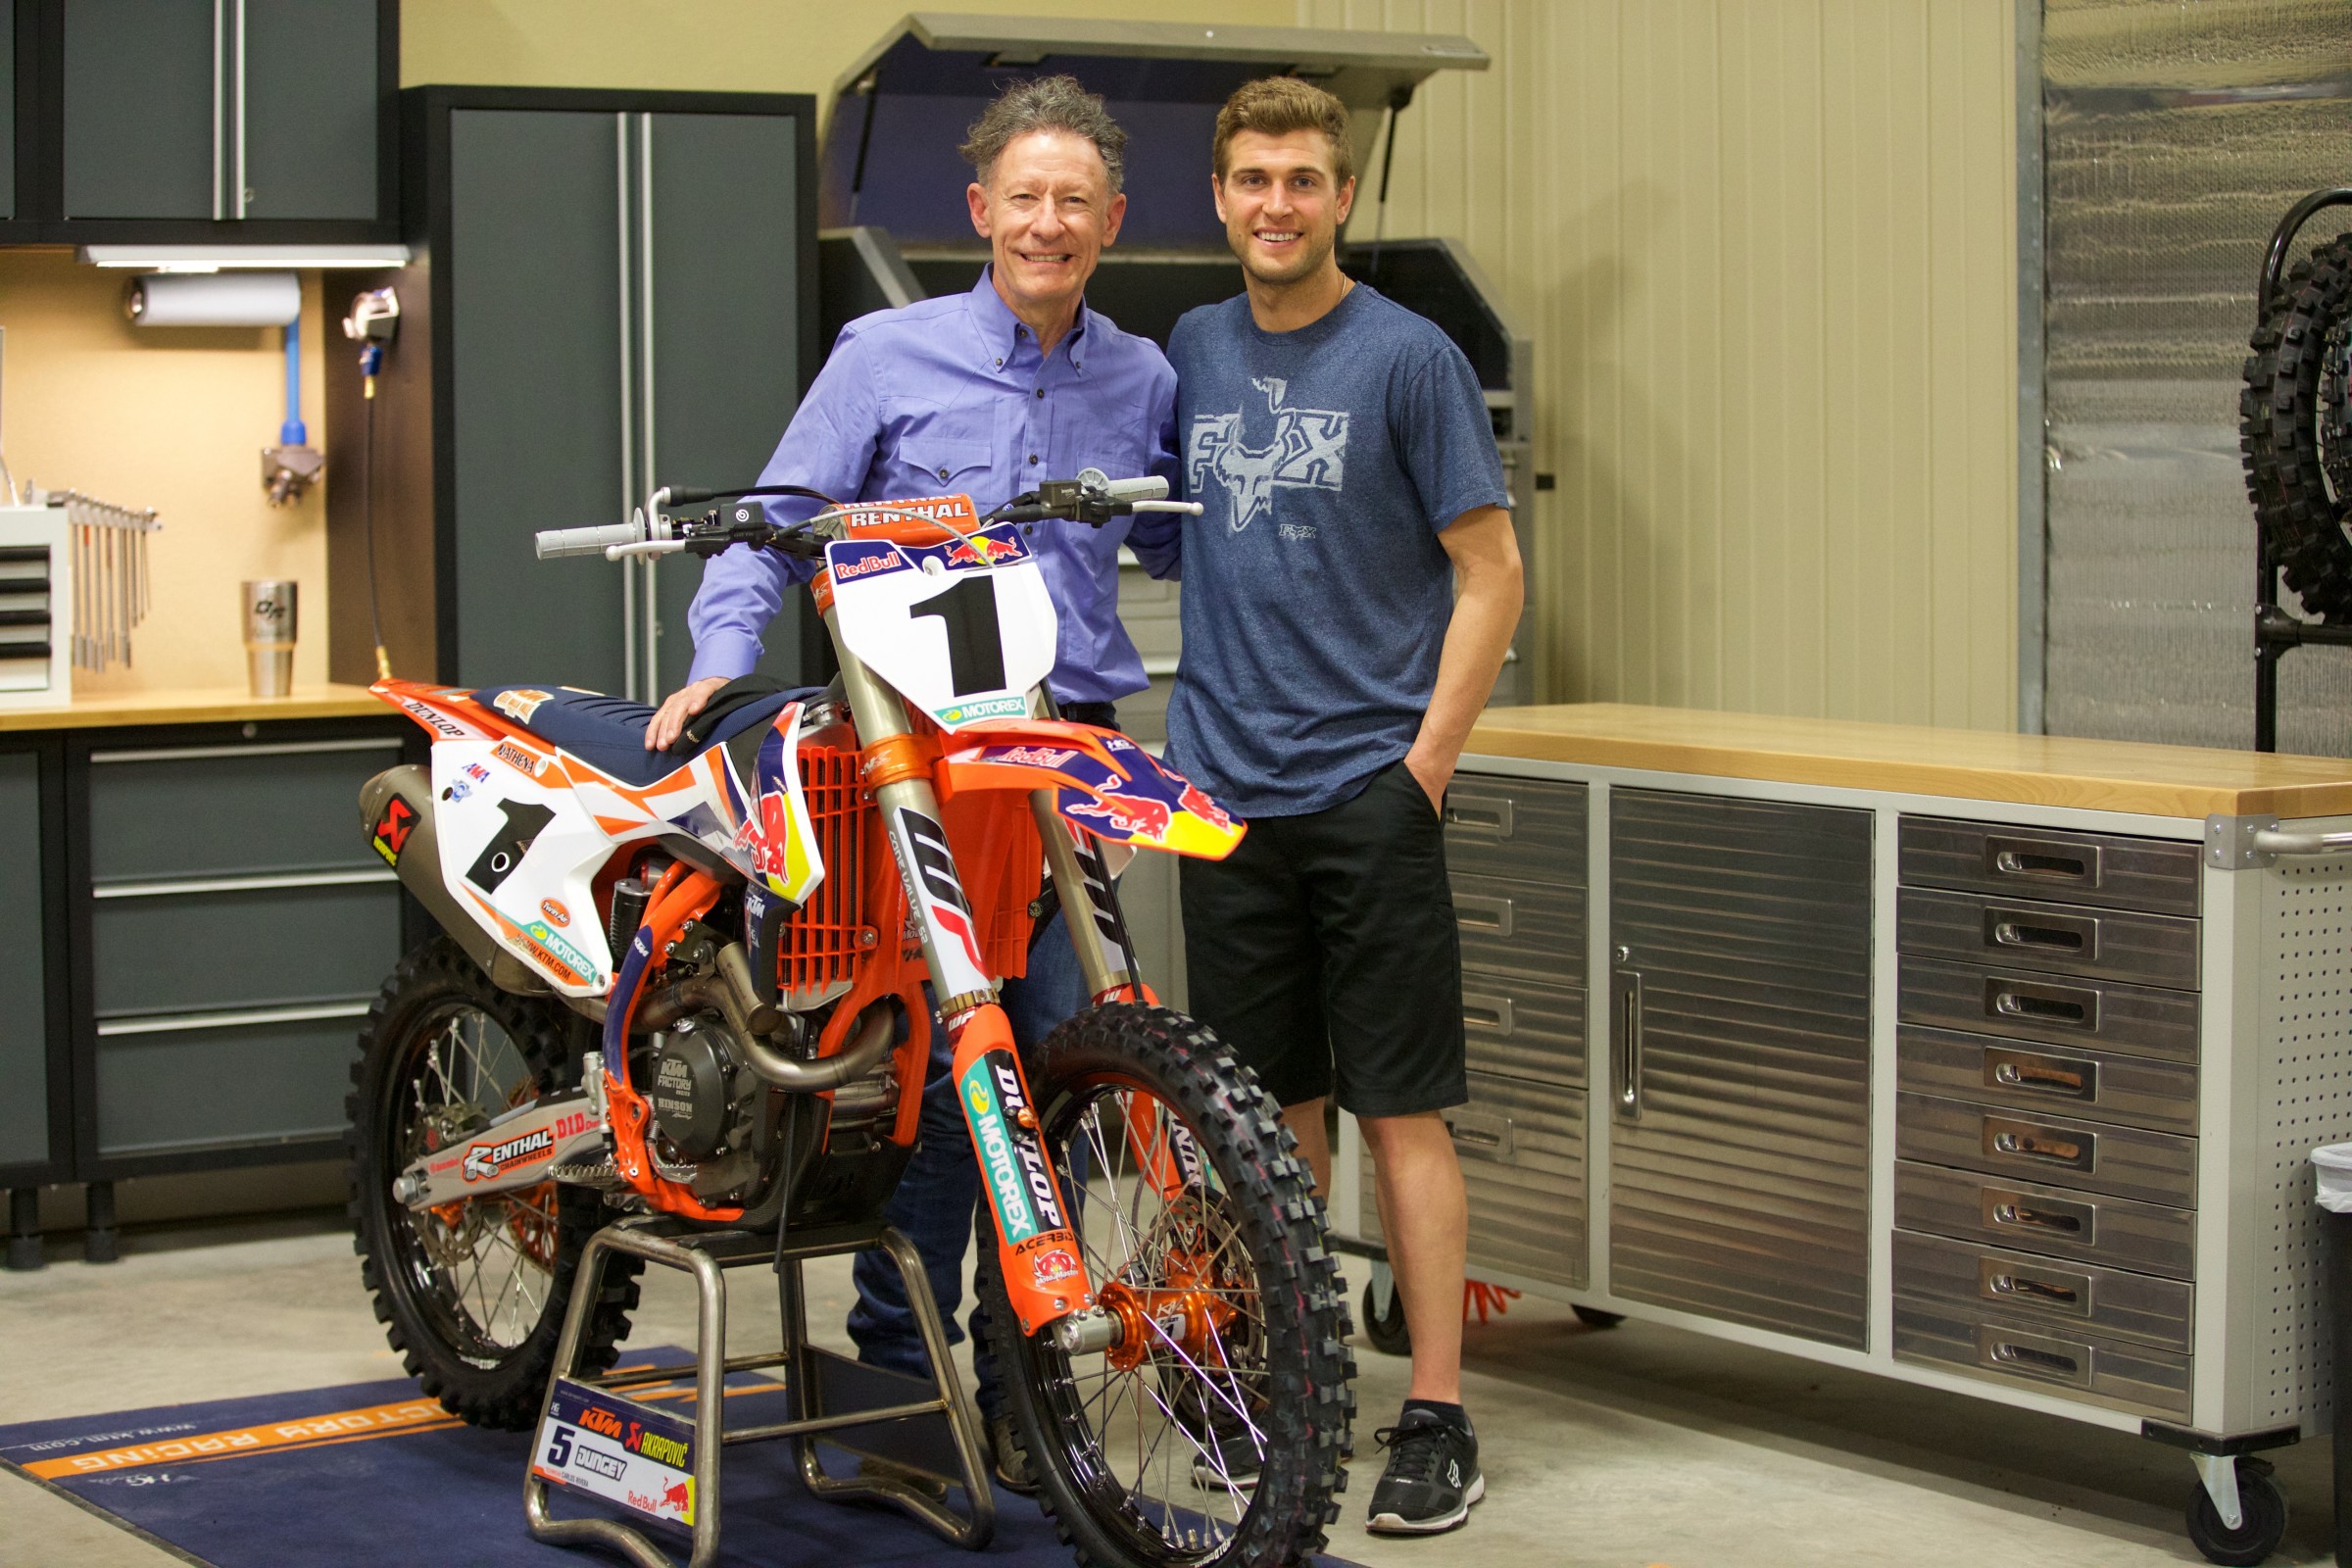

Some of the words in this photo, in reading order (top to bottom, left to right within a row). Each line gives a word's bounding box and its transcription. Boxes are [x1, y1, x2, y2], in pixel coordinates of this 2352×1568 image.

[850, 502, 969, 527] RENTHAL
[835, 557, 869, 580] Red
[867, 551, 902, 573] Bull
[909, 574, 1007, 698] 1
[406, 702, 466, 737] DUNLOP
[961, 698, 1025, 718] MOTOREX
[462, 762, 490, 784] AMA
[506, 748, 536, 773] ATHENA
[465, 797, 557, 896] 1
[542, 900, 559, 918] Twin
[557, 911, 568, 923] Air
[747, 894, 765, 919] KTM
[545, 932, 597, 981] MOTOREX
[633, 937, 649, 957] KTM
[661, 1058, 687, 1078] KTM
[658, 1075, 692, 1091] FACTORY
[658, 1098, 693, 1112] HINSON
[500, 1148, 553, 1171] CHAINWHEELS
[978, 1113, 1032, 1239] MOTOREX
[578, 1406, 622, 1439] KTM
[547, 1425, 575, 1468] 5
[628, 1491, 643, 1507] Red
[642, 1496, 658, 1512] Bull
